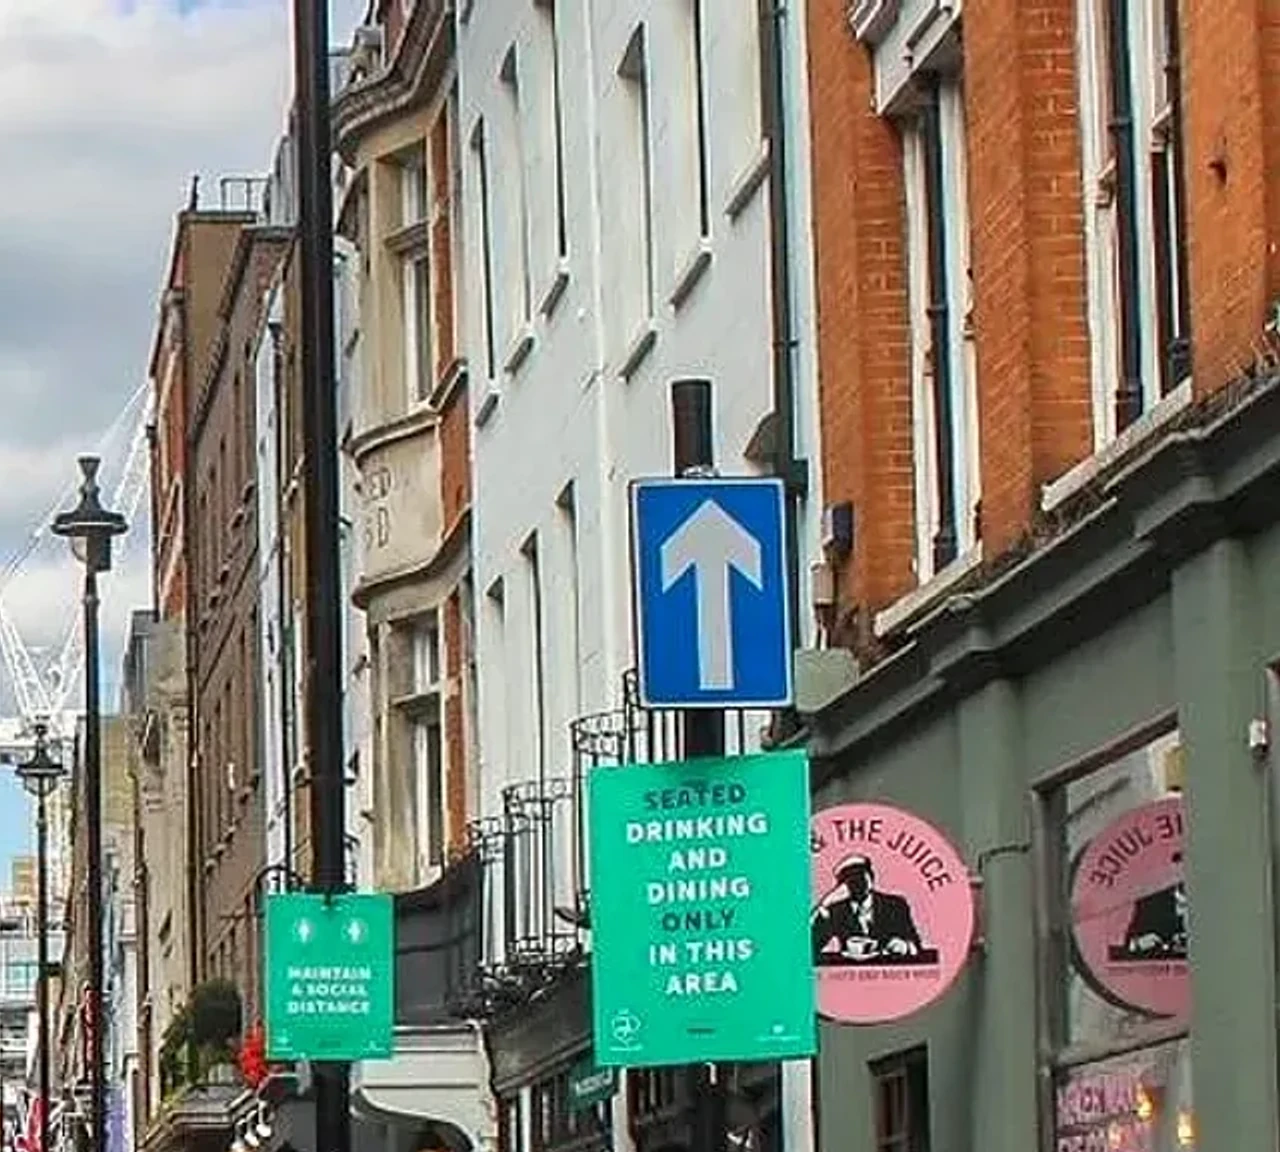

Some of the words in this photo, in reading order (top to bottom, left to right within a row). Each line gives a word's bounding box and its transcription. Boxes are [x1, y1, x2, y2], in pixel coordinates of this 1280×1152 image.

[644, 783, 747, 810] SEATED
[626, 813, 768, 843] DRINKING
[668, 848, 727, 872] AND
[831, 819, 883, 844] THE
[886, 831, 954, 892] JUICE
[647, 877, 750, 905] DINING
[661, 908, 737, 932] ONLY
[649, 944, 677, 966] IN
[686, 938, 754, 962] THIS
[288, 965, 372, 980] MAINTAIN
[665, 971, 738, 995] AREA
[306, 983, 369, 997] SOCIAL
[287, 1001, 371, 1014] DISTANCE
